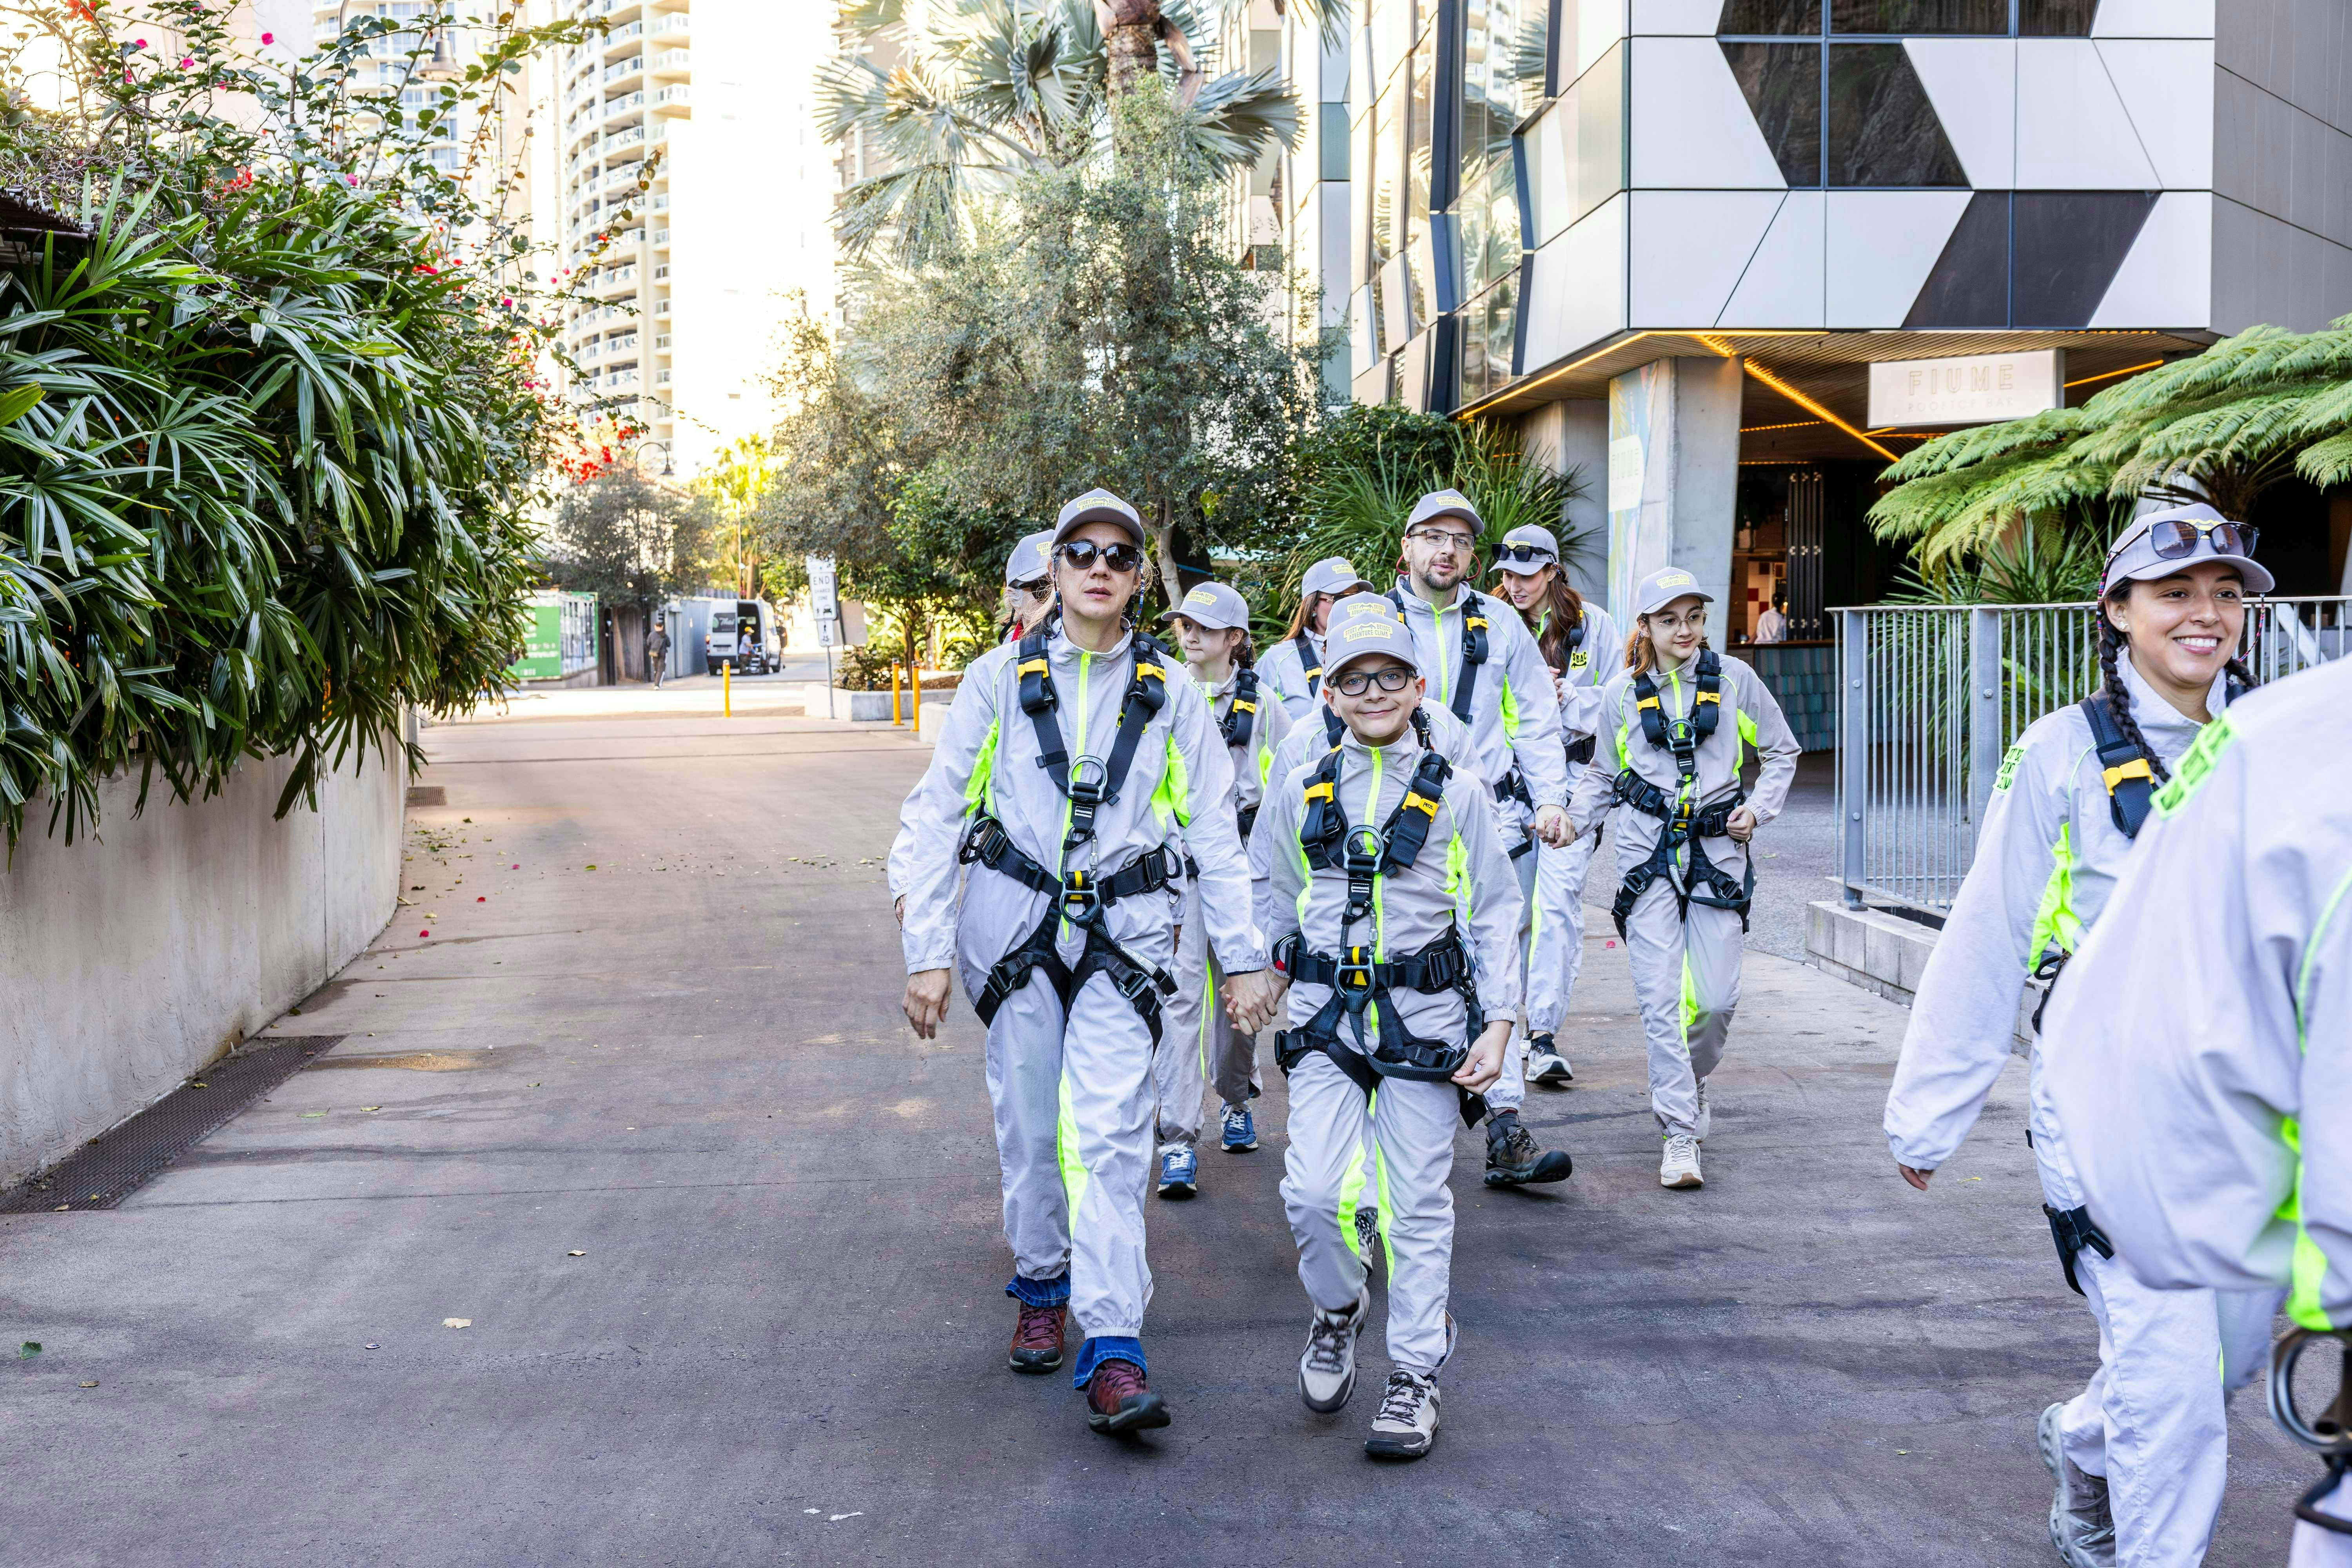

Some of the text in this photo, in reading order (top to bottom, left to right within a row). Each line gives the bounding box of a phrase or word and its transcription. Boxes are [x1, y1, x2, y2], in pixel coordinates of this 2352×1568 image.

[1909, 364, 2014, 396] FIUME
[1987, 397, 2013, 408] BAR
[813, 576, 830, 585] END
[1345, 624, 1391, 635] STORY BRIDGE
[1349, 630, 1373, 640] ADVENTURE
[1573, 652, 1586, 663] SBAC
[1423, 802, 1434, 810] PETZL
